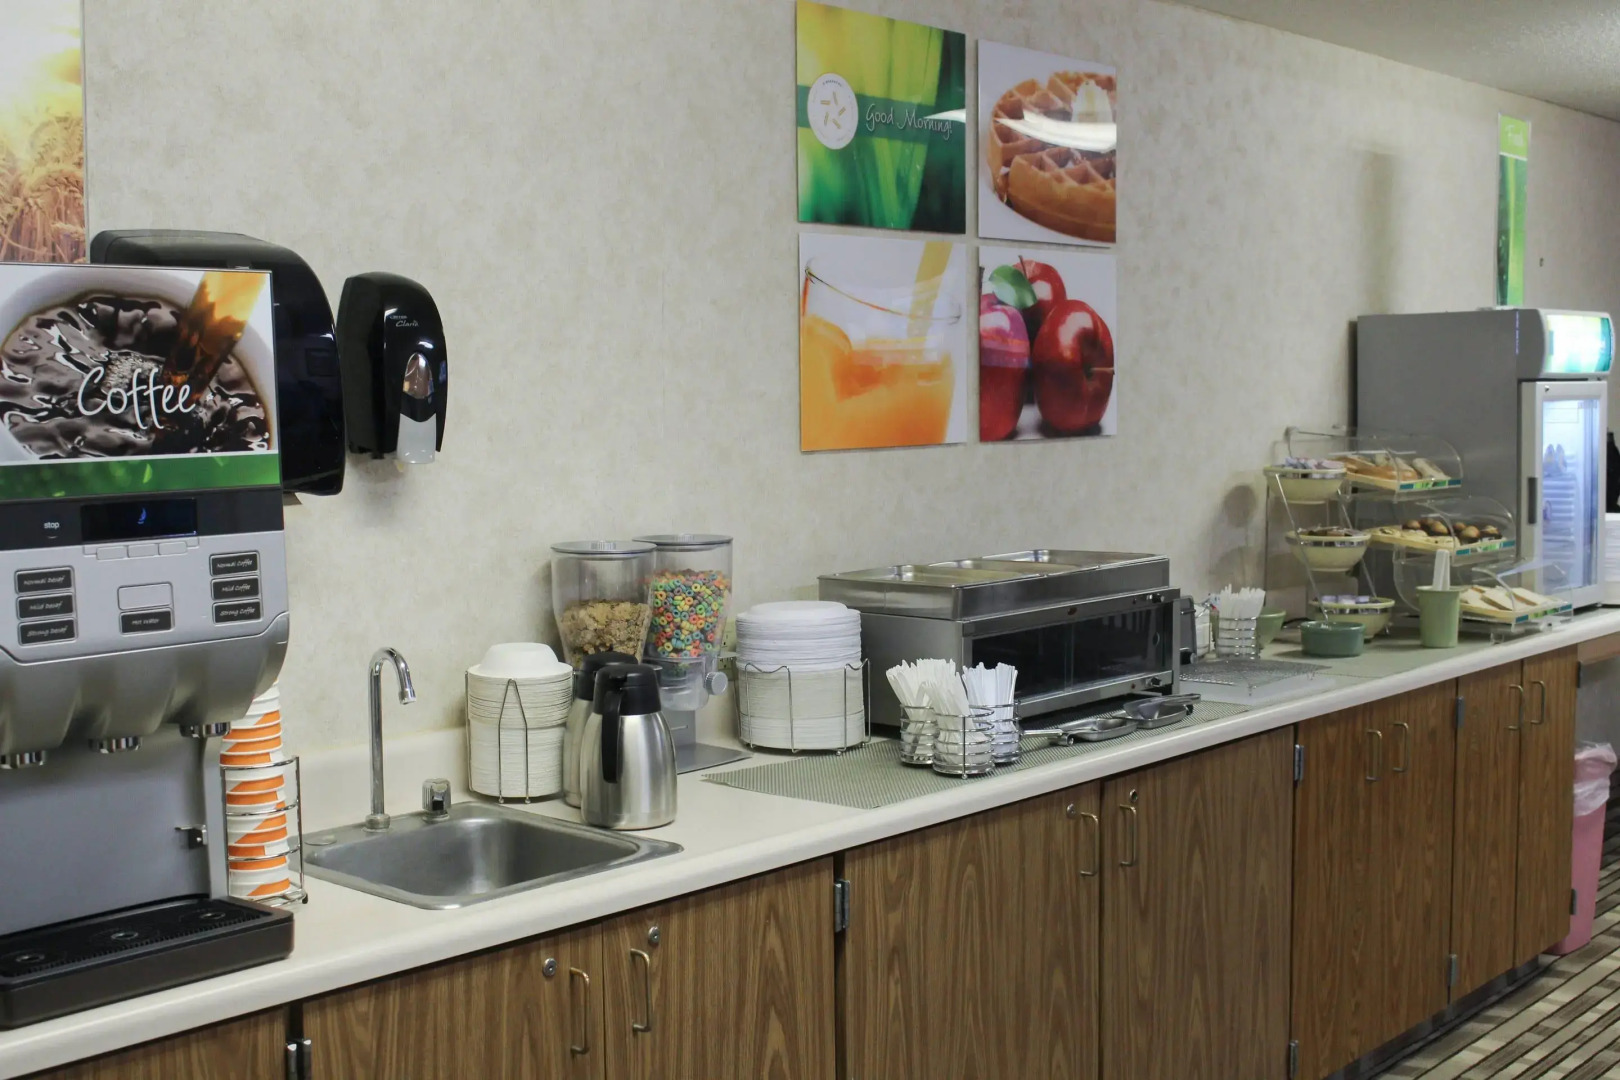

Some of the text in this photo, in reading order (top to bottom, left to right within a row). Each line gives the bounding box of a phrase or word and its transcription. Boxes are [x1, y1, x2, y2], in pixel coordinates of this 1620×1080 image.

[865, 103, 953, 141] Good Morning!
[77, 366, 196, 430] Coffee
[43, 521, 60, 530] stop
[237, 558, 253, 567] Coffee
[235, 583, 251, 592] Coffee
[240, 606, 256, 616] Coffee
